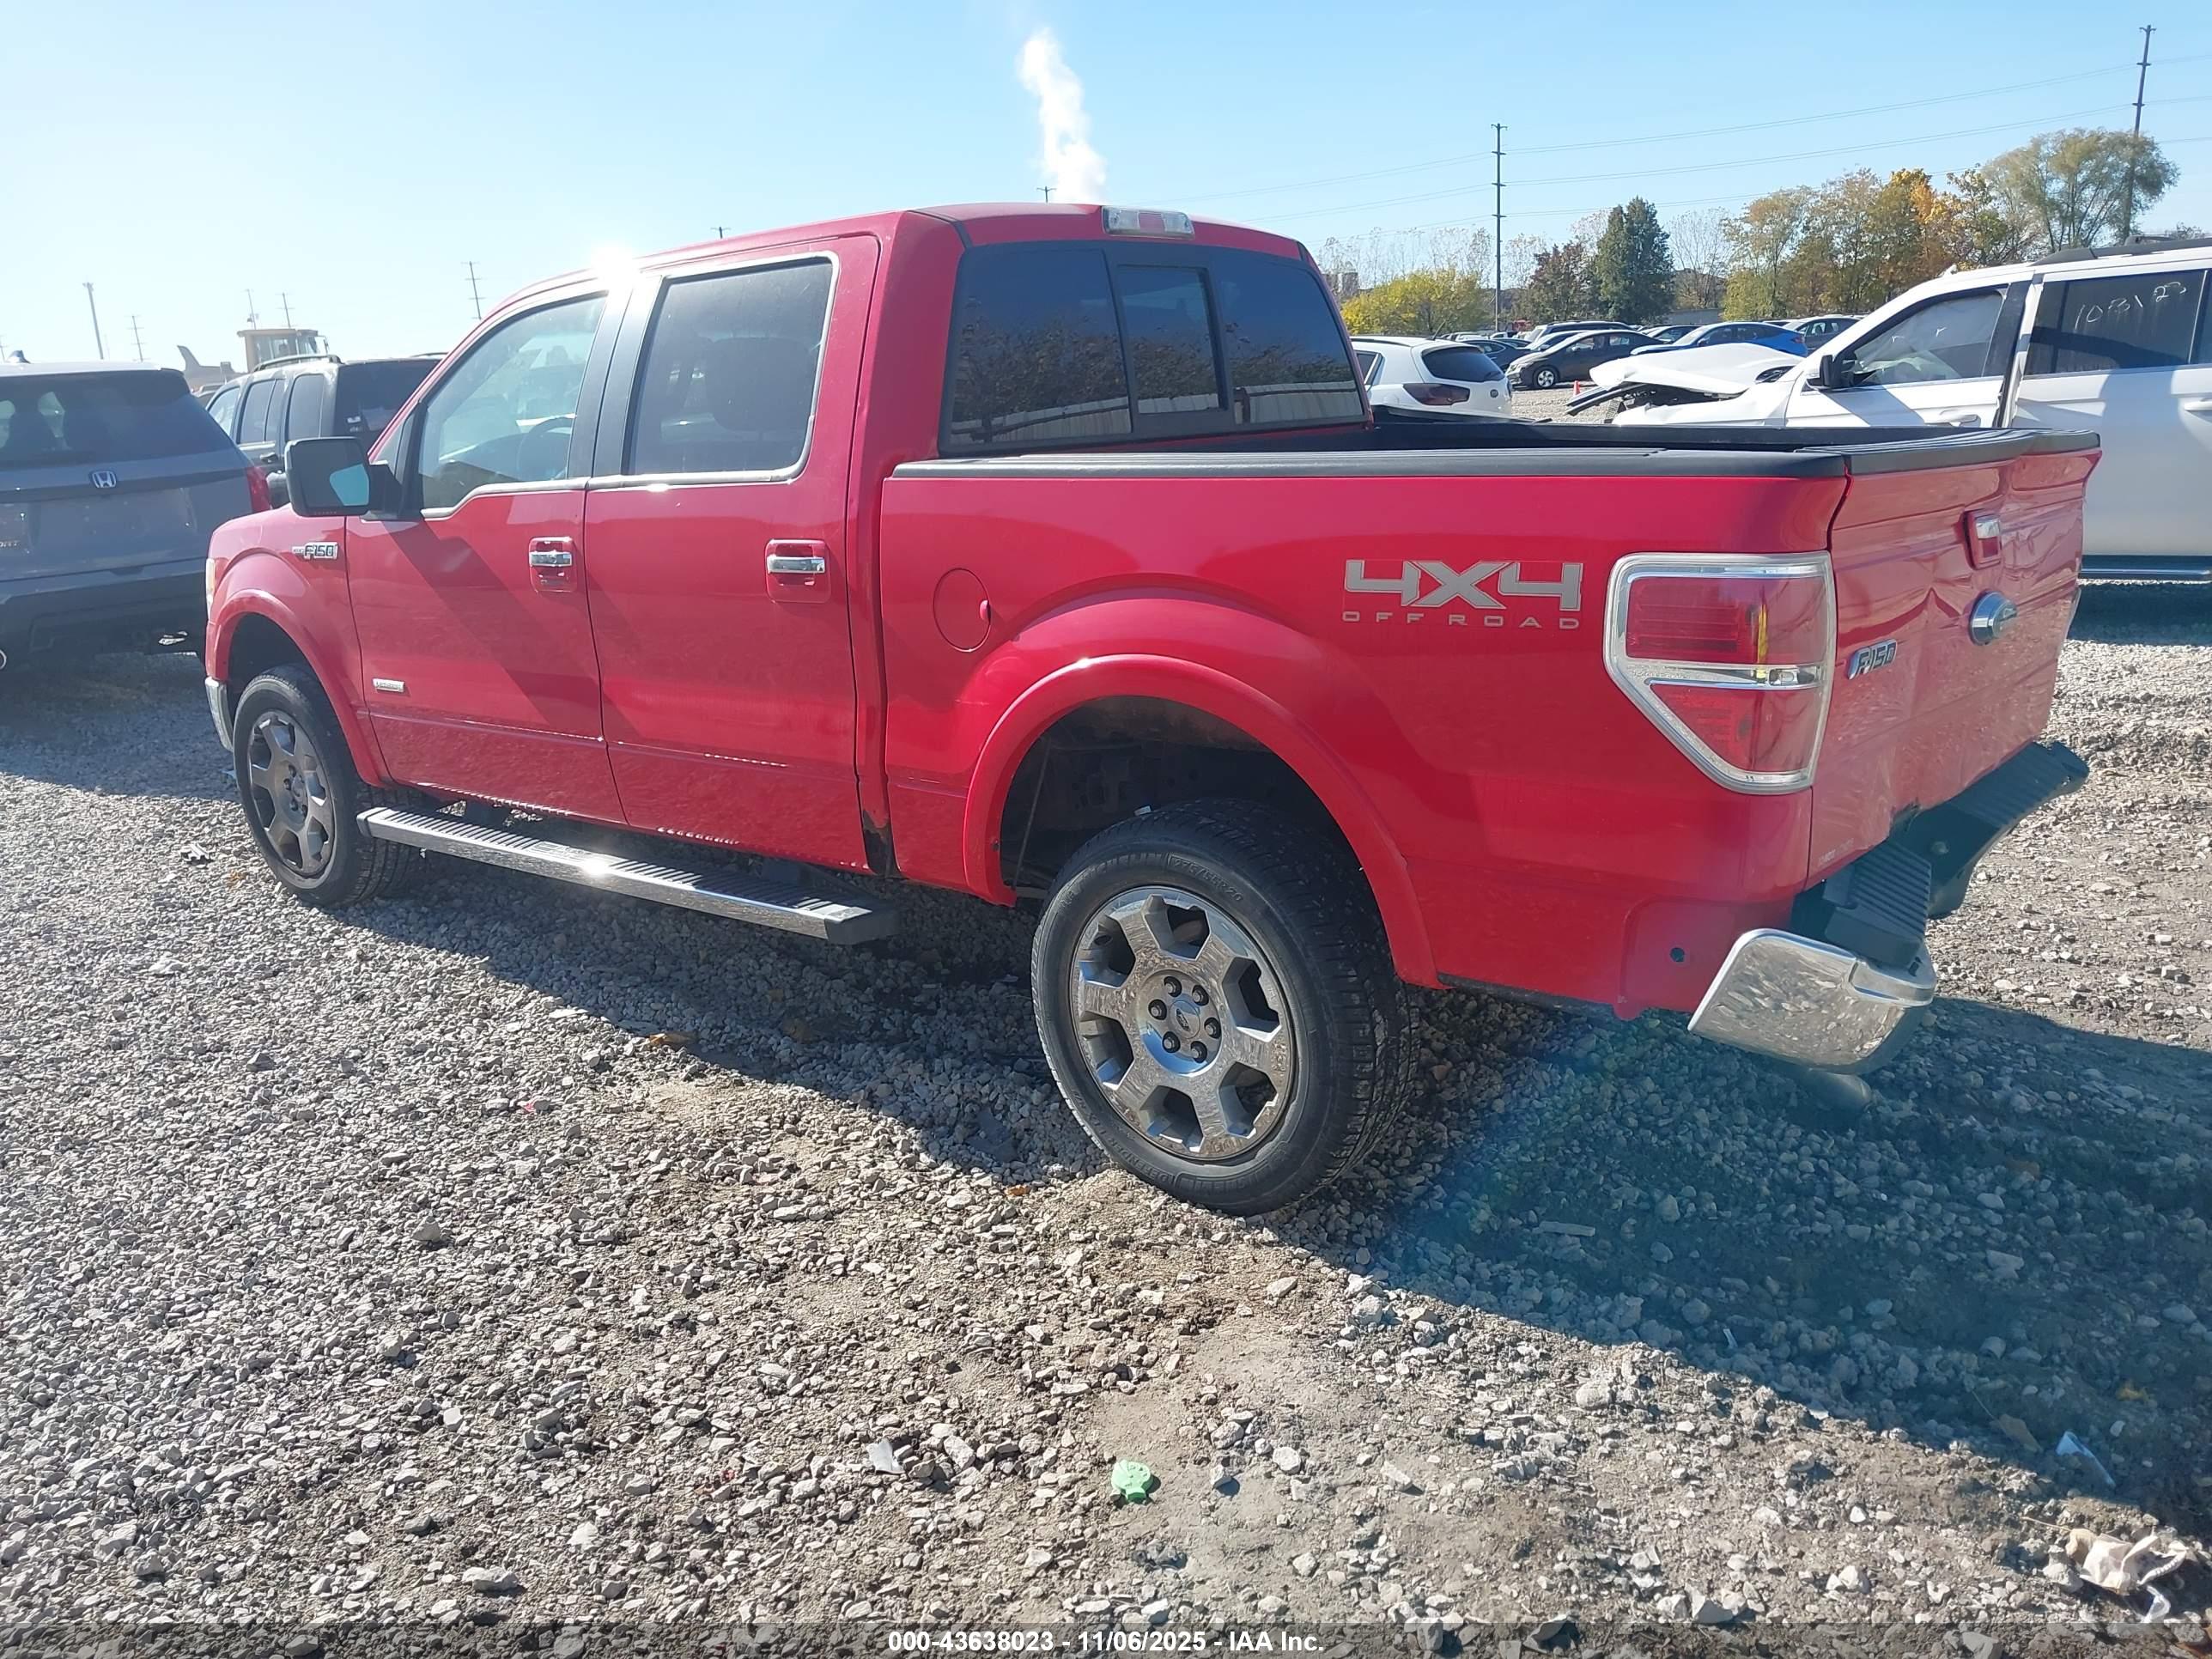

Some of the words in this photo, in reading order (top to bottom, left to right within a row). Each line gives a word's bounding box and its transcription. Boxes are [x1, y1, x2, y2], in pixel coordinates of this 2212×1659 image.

[1345, 559, 1583, 611] 4X4
[1341, 611, 1425, 624] OFF
[1448, 613, 1580, 630] ROAD
